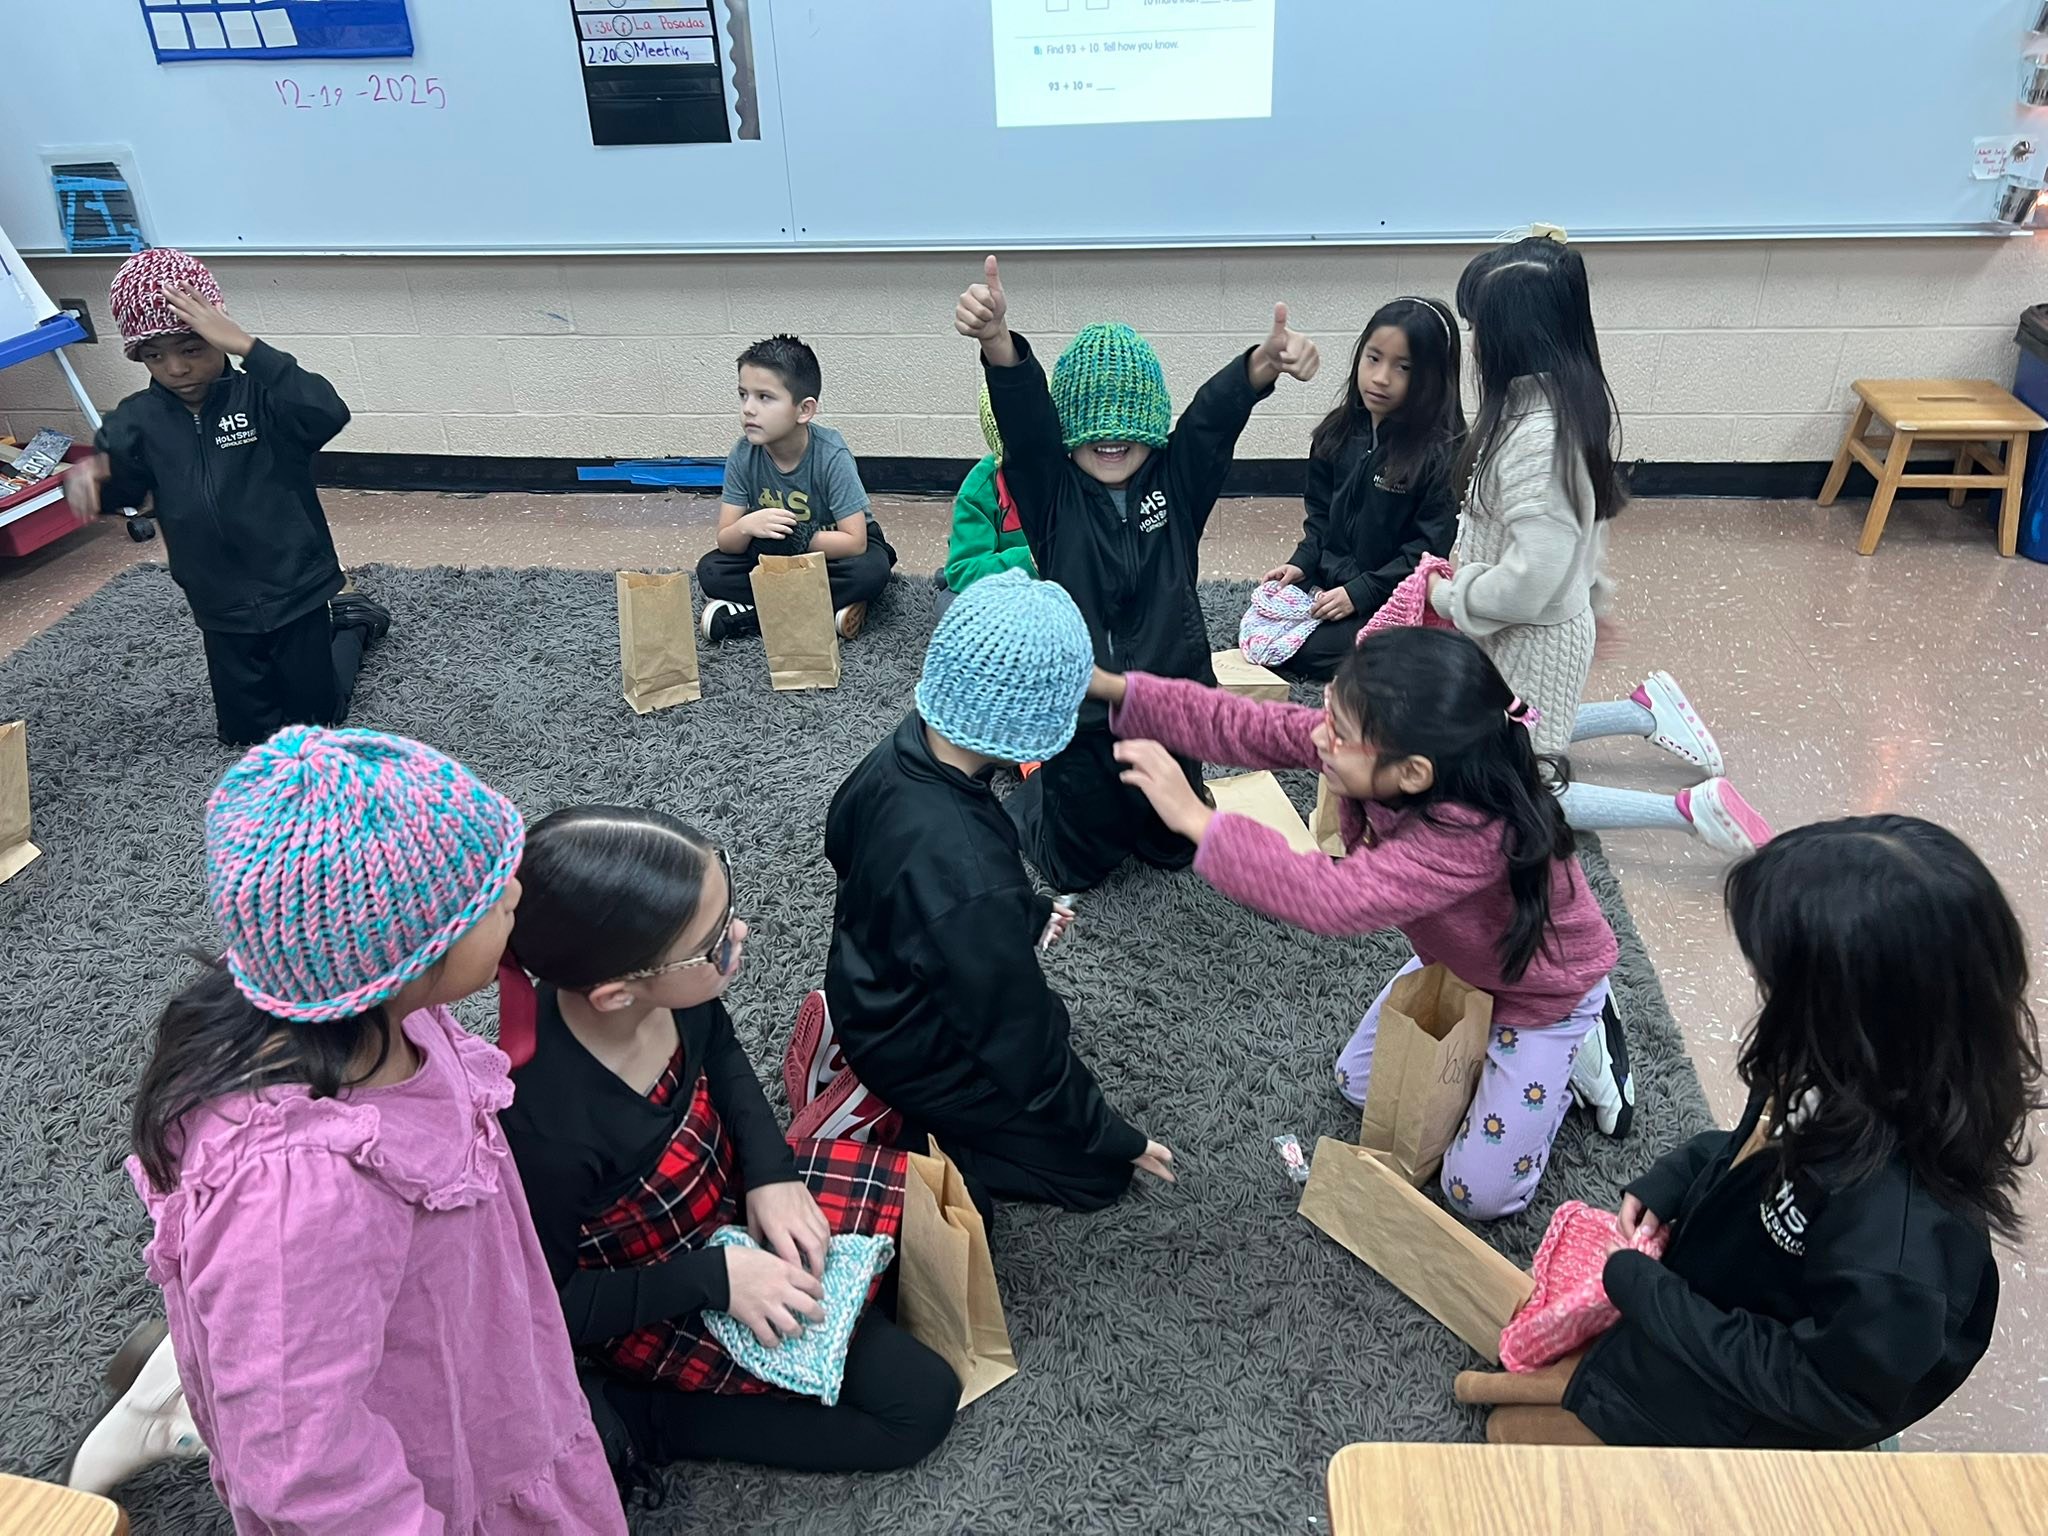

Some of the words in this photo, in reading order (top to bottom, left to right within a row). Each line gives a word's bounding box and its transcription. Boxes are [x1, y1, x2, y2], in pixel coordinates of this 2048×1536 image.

[632, 16, 652, 31] La
[658, 15, 705, 31] Posadas
[588, 46, 617, 64] 2:20
[633, 41, 690, 60] Meeting
[1047, 44, 1064, 55] Find
[1066, 43, 1077, 54] 93
[1118, 41, 1136, 51] how
[1138, 42, 1153, 53] you
[1048, 81, 1060, 91] 93
[1073, 80, 1083, 90] 10
[219, 413, 248, 431] HS
[1140, 491, 1167, 515] HS
